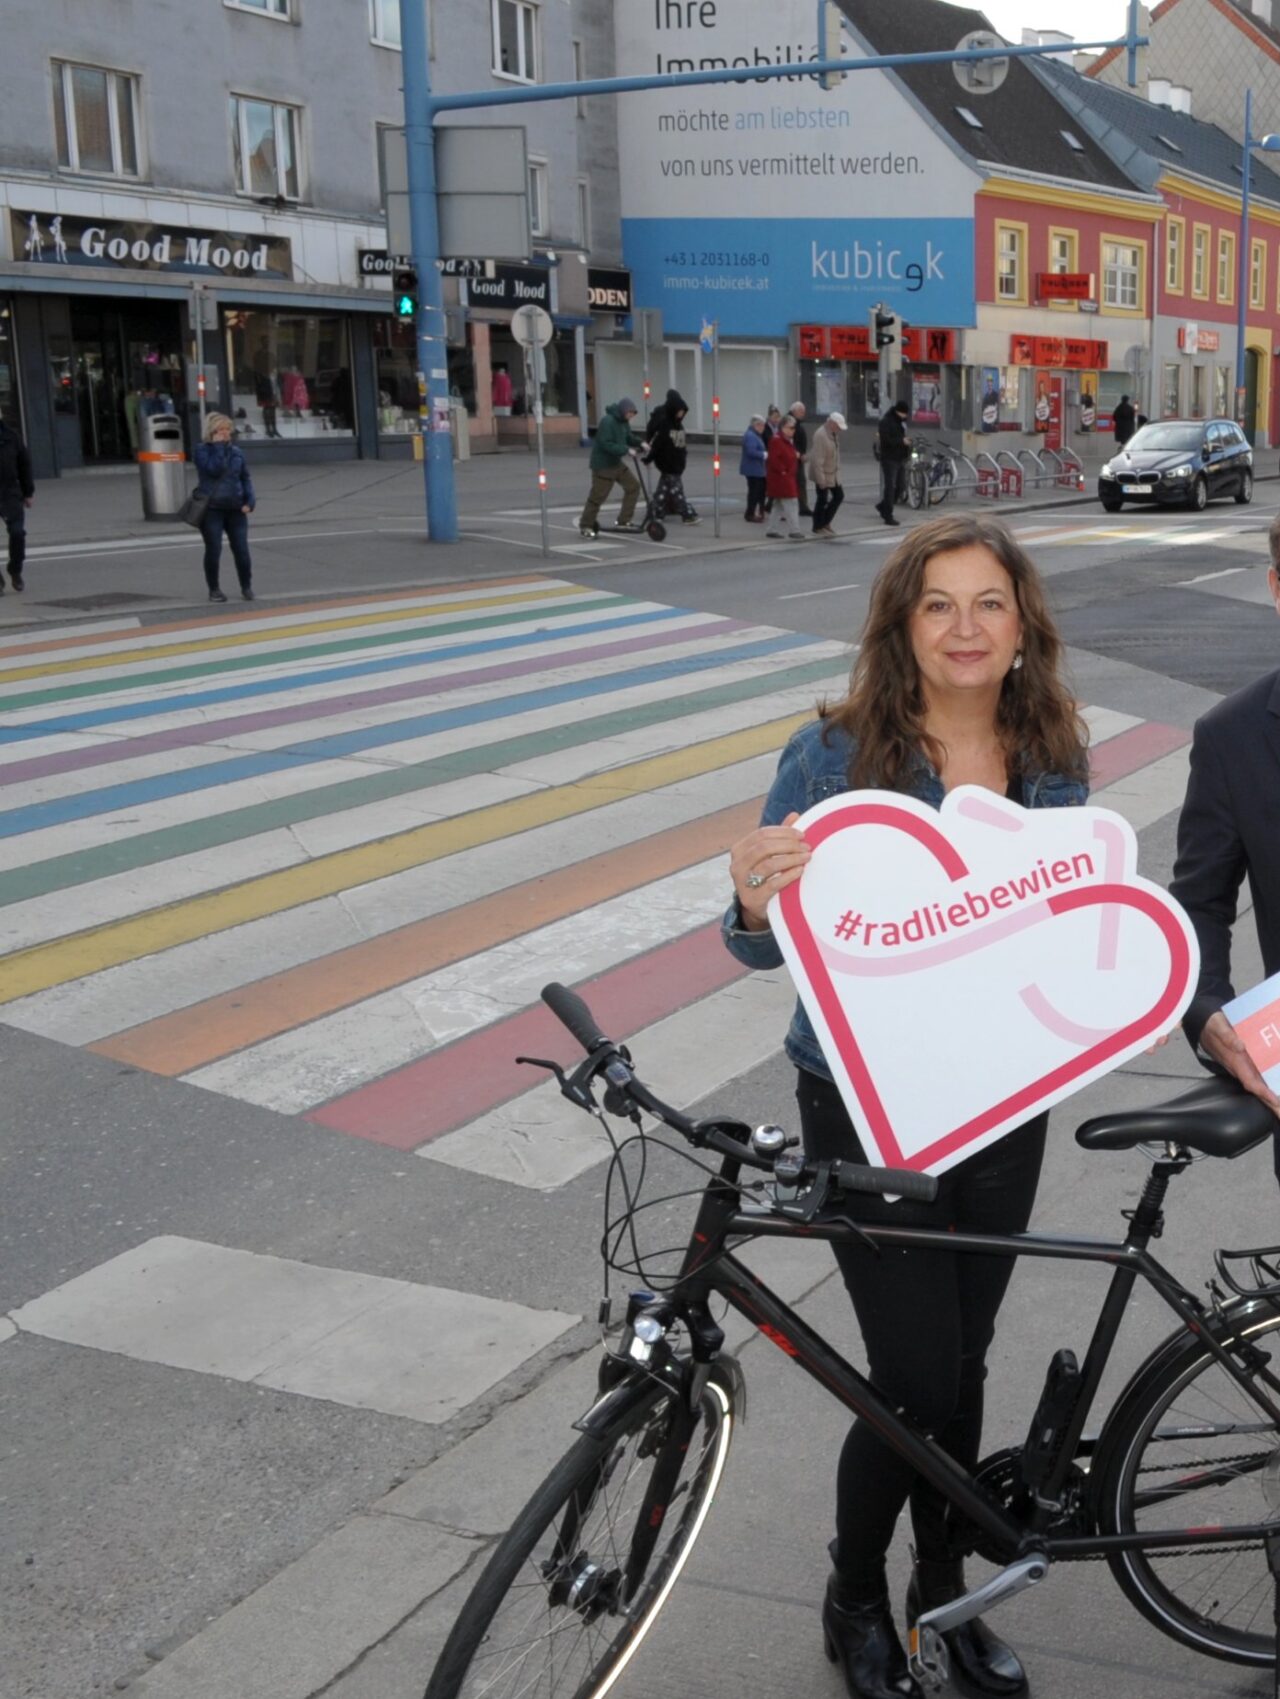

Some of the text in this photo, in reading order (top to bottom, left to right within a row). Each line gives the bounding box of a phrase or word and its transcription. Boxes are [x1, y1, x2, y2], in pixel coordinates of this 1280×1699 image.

[655, 0, 716, 29] Ihre
[658, 106, 850, 132] möchte am liebsten
[660, 152, 925, 177] von uns vermittelt werden.
[80, 227, 268, 271] Good Mood
[664, 252, 770, 267] +43 1 2031168-0
[471, 278, 546, 299] Good Mood
[663, 275, 769, 290] immo-kubicek.at
[834, 851, 1095, 947] #radliebewien
